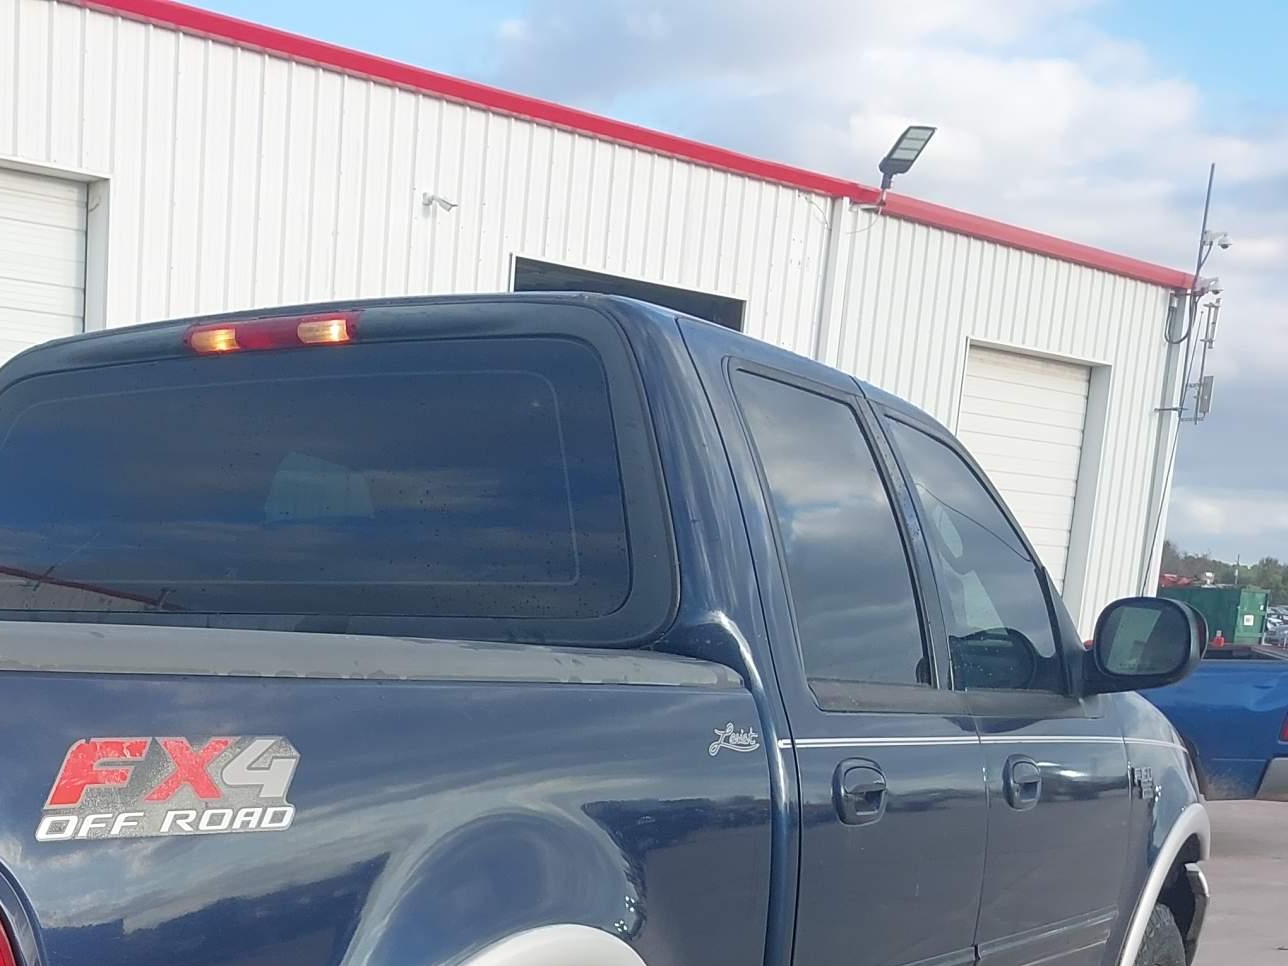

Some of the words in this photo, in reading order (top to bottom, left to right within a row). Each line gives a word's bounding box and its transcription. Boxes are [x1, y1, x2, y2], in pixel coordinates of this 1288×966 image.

[44, 737, 299, 807] FX4
[36, 811, 145, 840] OFF
[160, 806, 296, 833] ROAD
